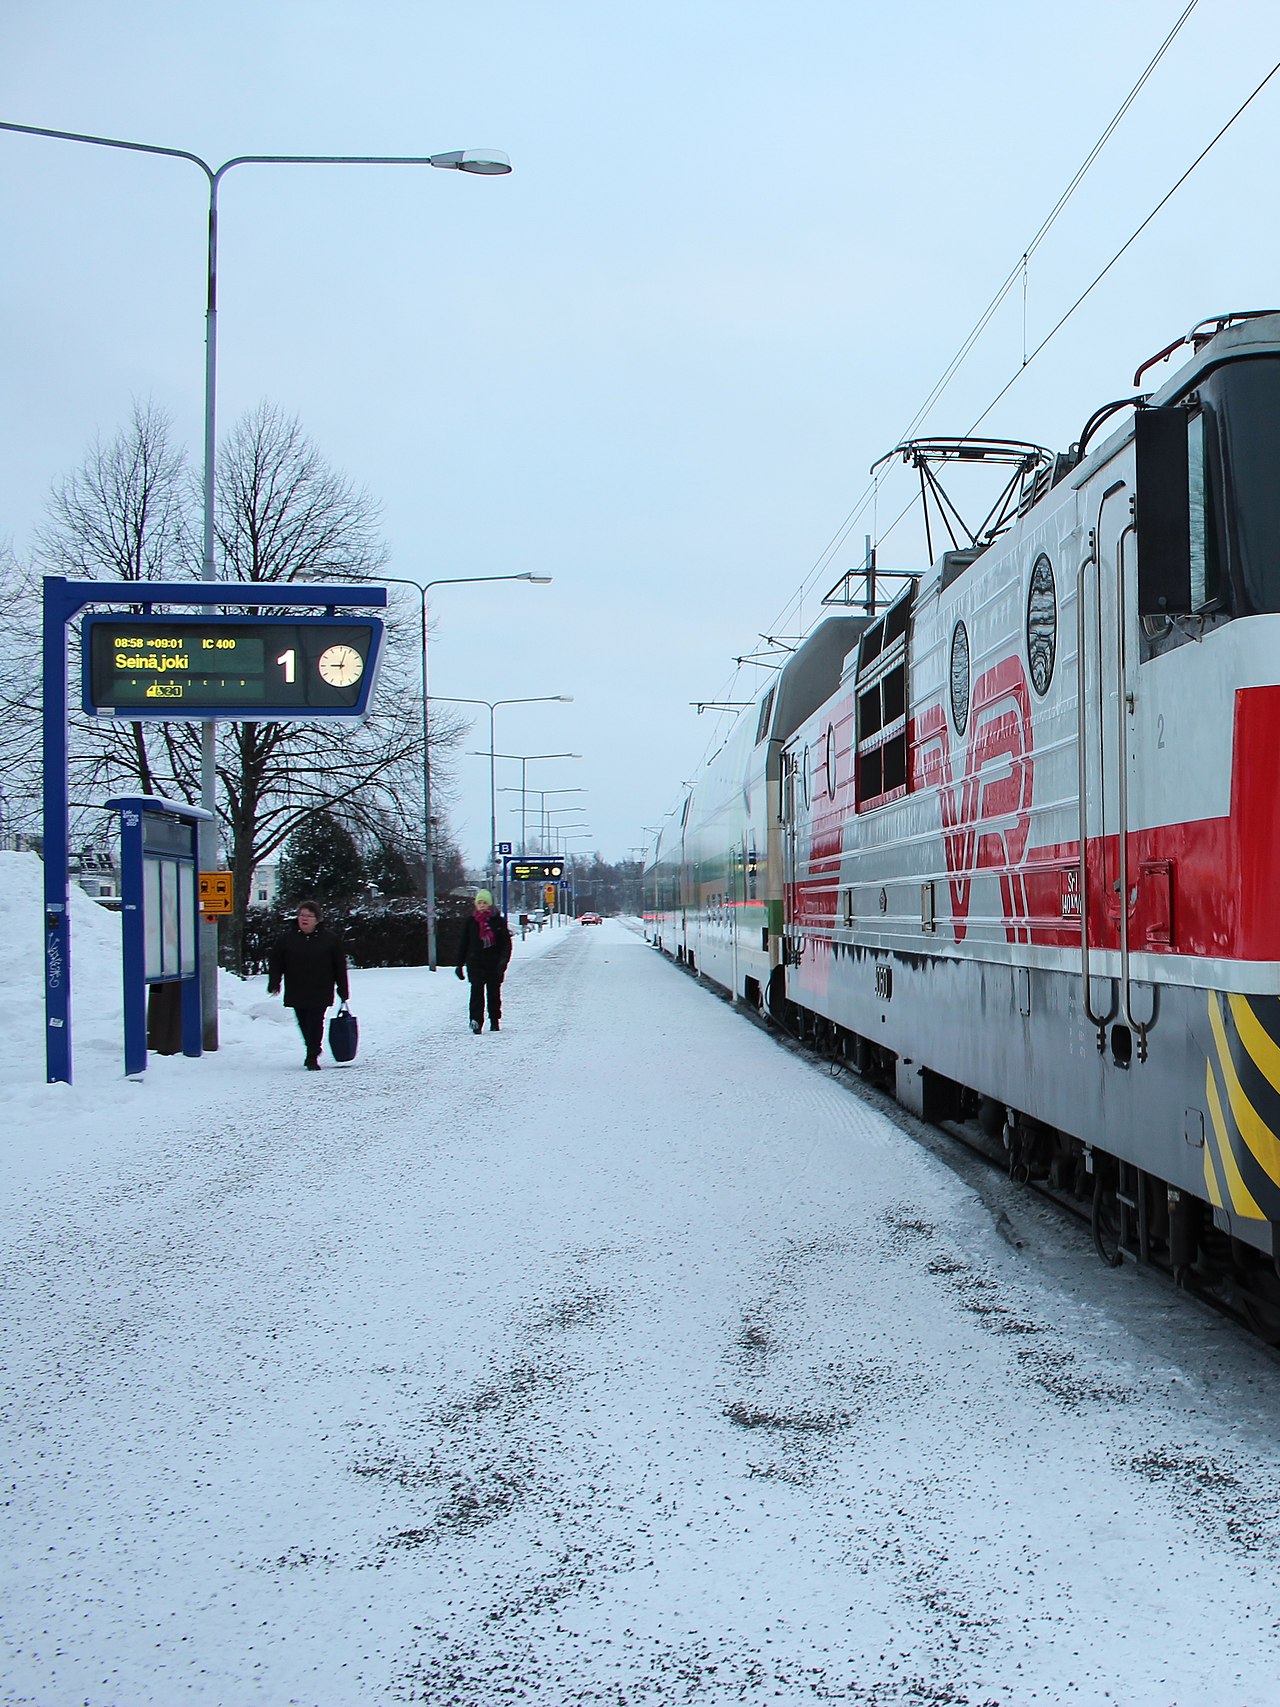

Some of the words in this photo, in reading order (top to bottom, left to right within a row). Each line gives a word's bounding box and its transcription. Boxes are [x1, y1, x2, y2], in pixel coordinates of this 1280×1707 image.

[114, 638, 144, 648] 08:58
[154, 639, 183, 648] 09:01
[202, 639, 214, 649] IC
[216, 639, 236, 649] 400
[115, 654, 189, 672] Seinäjoki
[278, 650, 295, 683] 1
[1157, 714, 1165, 749] 2
[917, 655, 1034, 945] VR
[502, 844, 510, 853] B
[543, 868, 549, 876] 1
